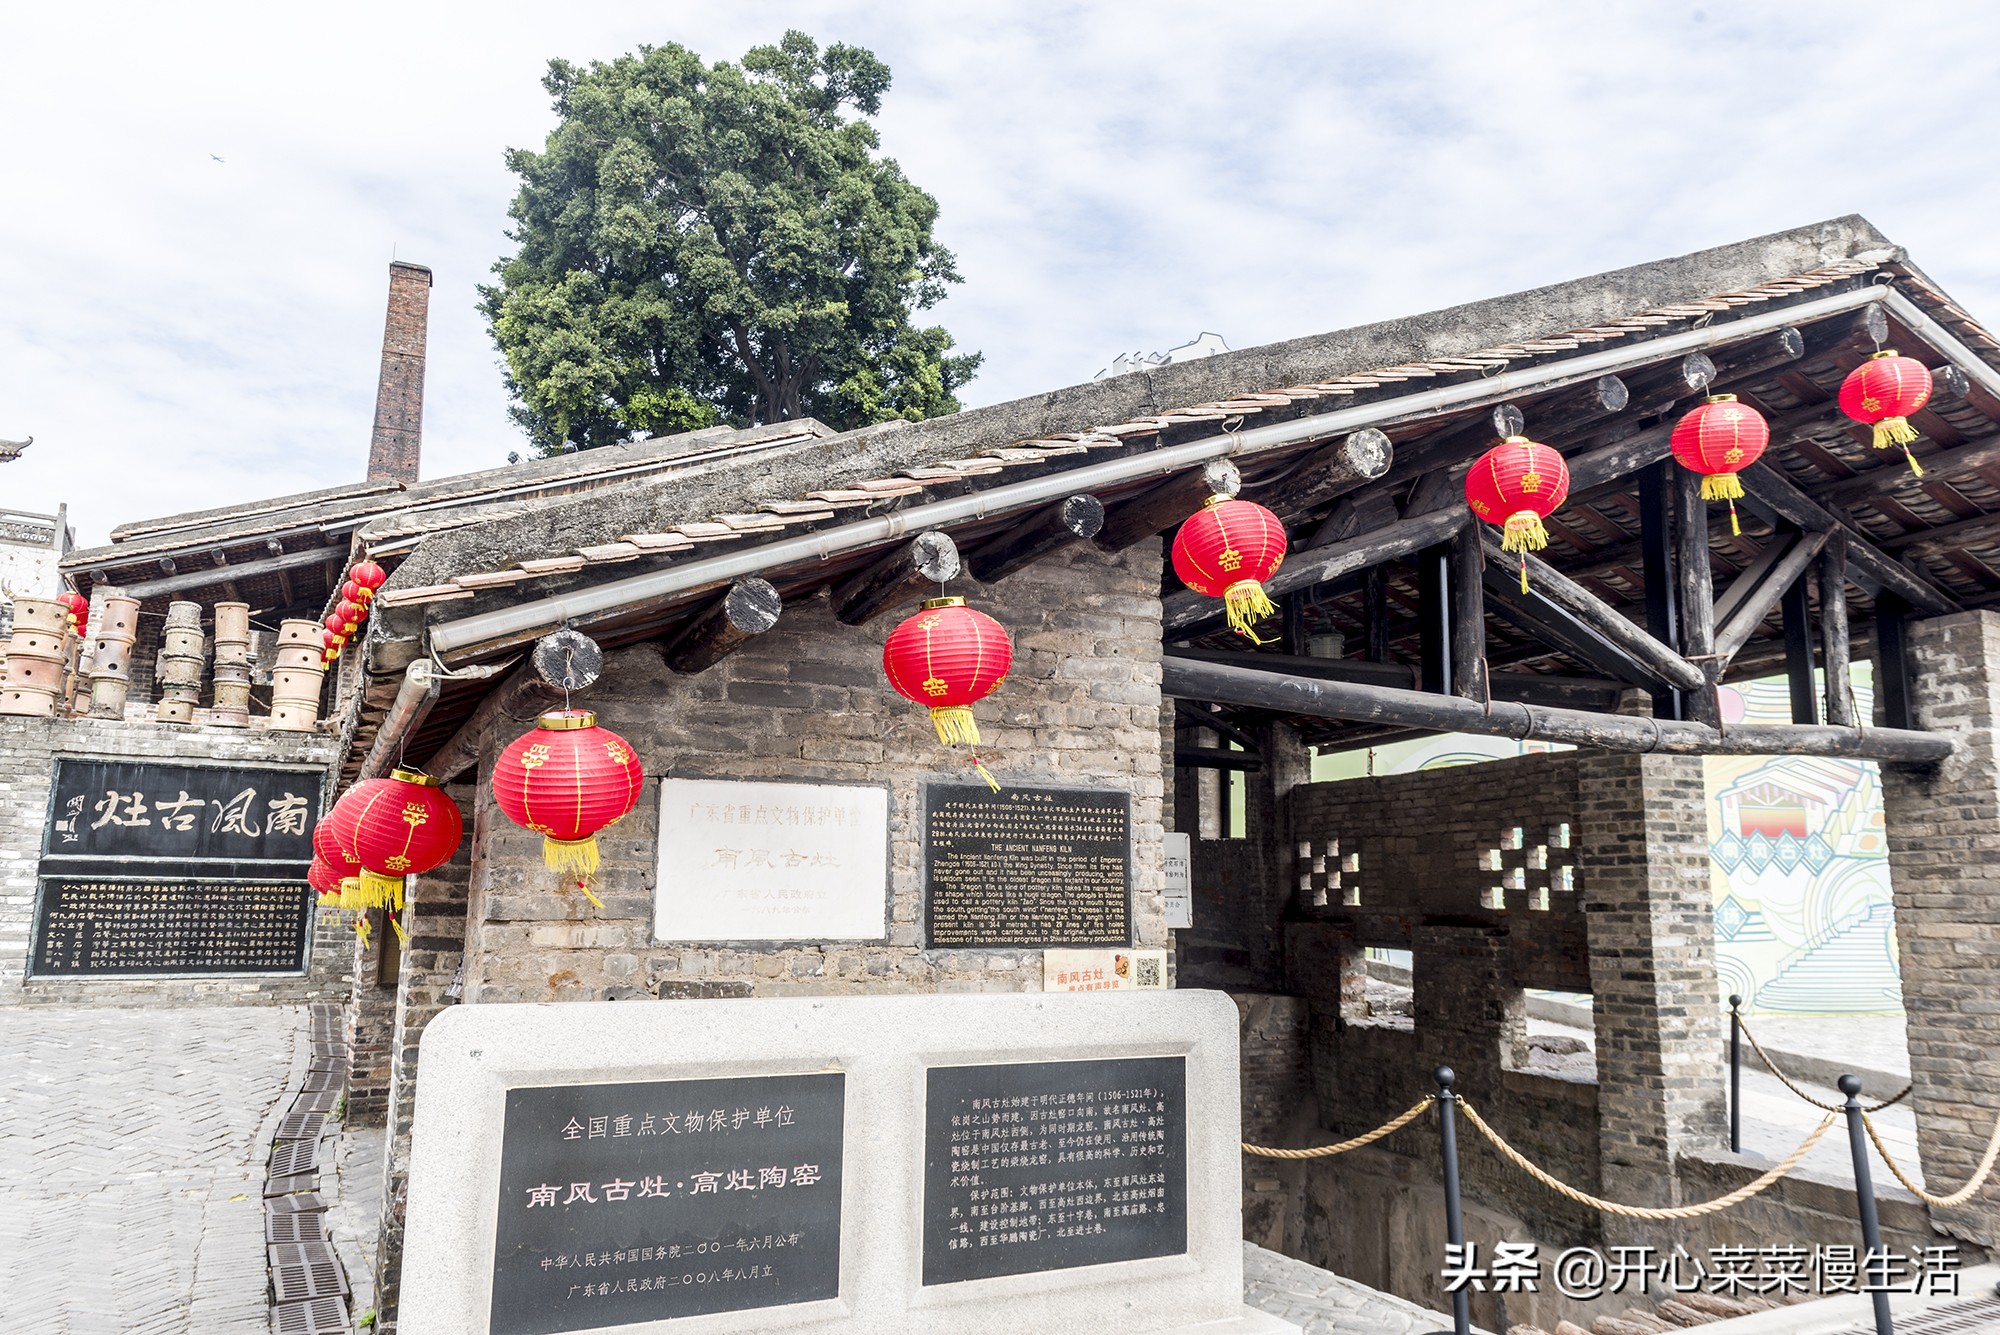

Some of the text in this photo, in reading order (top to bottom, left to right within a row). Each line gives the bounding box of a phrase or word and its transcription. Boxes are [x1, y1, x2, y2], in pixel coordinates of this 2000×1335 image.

[688, 801, 861, 828] 广东省重点文物保护单位
[1031, 844, 1056, 852] NANFENG
[1723, 842, 1824, 859] 南风古灶
[970, 913, 995, 921] Nanfeng
[1031, 913, 1055, 921] Nanfeng
[1057, 968, 1104, 985] 南风古灶
[561, 1105, 795, 1141] 全国重点文物保护单位
[526, 1163, 822, 1208] 南风古灶·高灶陶窑
